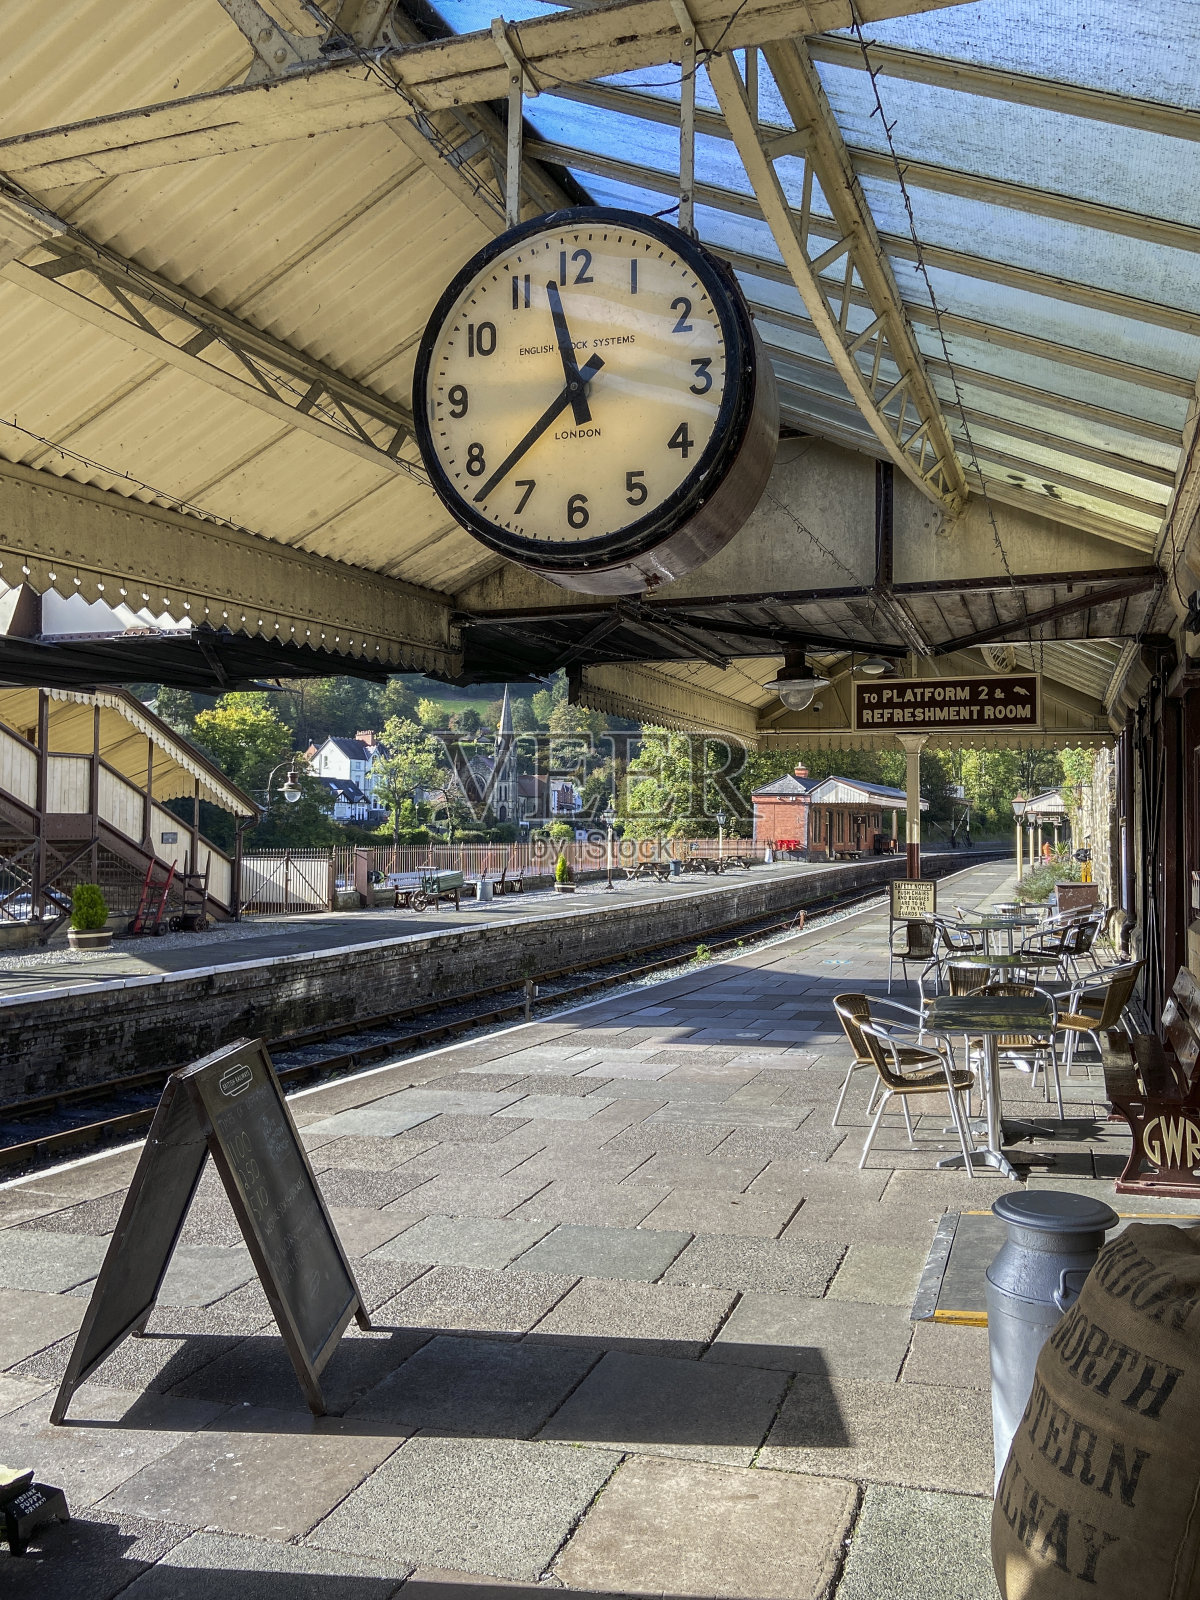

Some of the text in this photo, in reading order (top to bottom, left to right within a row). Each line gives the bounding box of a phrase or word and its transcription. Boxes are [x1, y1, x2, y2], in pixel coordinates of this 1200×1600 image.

[559, 249, 594, 287] 12
[630, 258, 638, 294] 1
[512, 274, 532, 310] 11
[669, 296, 693, 333] 2
[467, 321, 497, 357] 10
[519, 345, 554, 356] ENGLISH
[593, 335, 636, 348] SYSTEMS
[689, 357, 713, 395] 3
[447, 384, 469, 419] 9
[555, 428, 601, 440] LONDON
[667, 422, 694, 459] 4
[465, 442, 486, 477] 8
[514, 479, 536, 515] 7
[625, 470, 648, 506] 5
[566, 493, 590, 530] 6
[863, 685, 1005, 704] TO PLATFORM 2 &
[862, 704, 1031, 723] REFRESHMENT ROOM
[1143, 1115, 1200, 1171] GWR
[1050, 1303, 1185, 1422] NORTH
[19, 1491, 43, 1510] PUPPY
